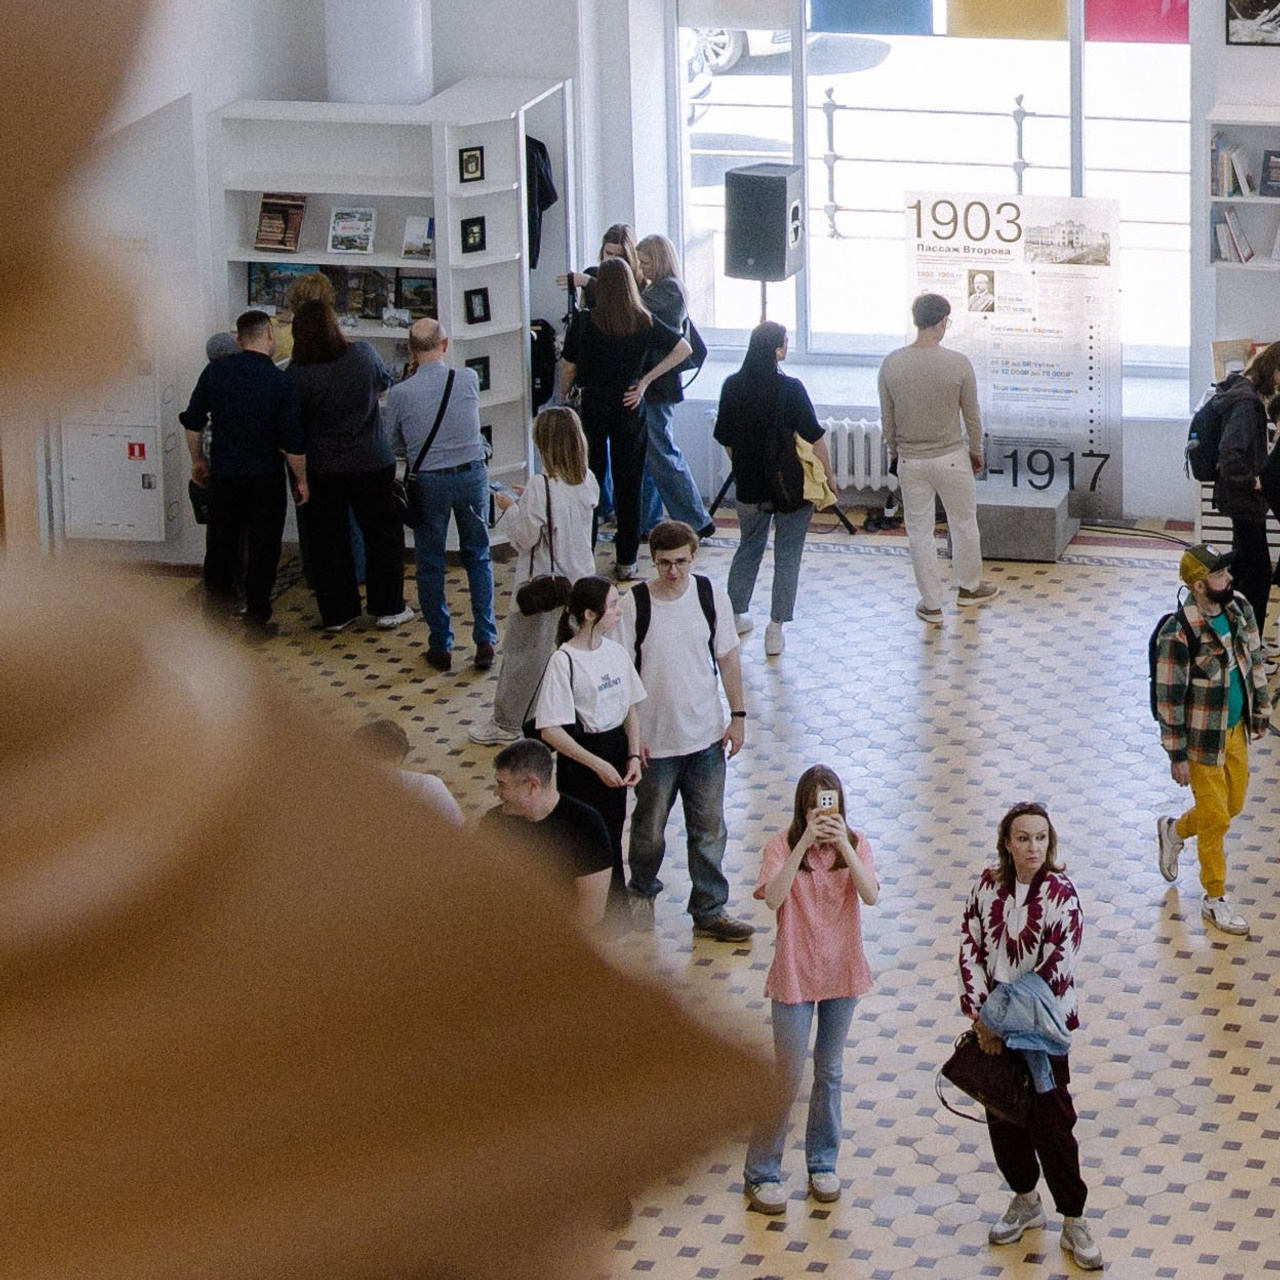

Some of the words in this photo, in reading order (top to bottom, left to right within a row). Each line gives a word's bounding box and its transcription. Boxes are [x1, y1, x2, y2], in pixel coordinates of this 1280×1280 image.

[906, 199, 1022, 243] 1903
[917, 243, 960, 253] Пассаж
[963, 245, 1011, 256] Второва
